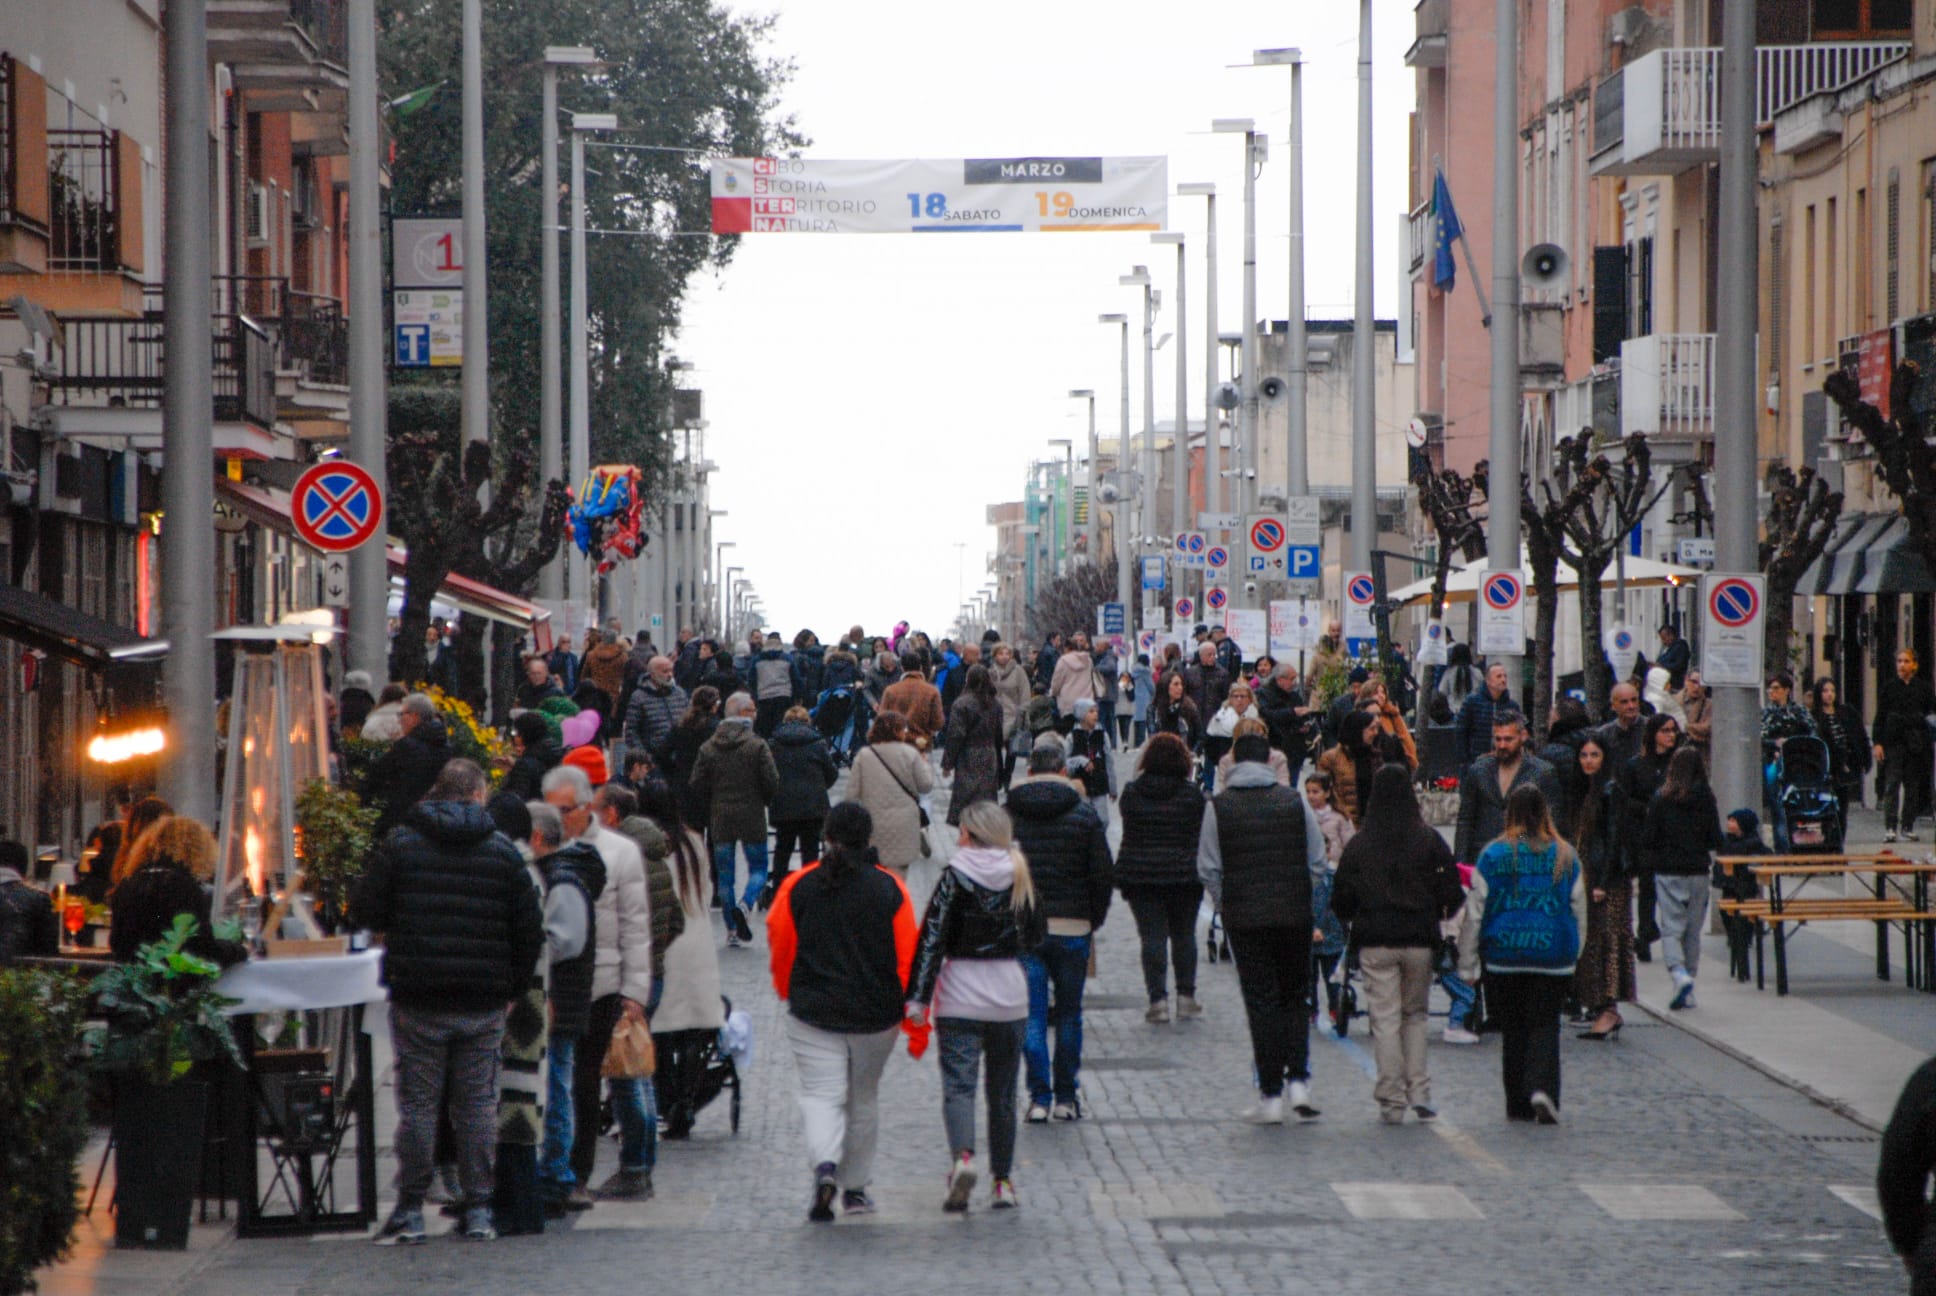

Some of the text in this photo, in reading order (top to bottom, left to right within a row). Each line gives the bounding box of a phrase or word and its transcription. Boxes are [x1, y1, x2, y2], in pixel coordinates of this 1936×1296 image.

[755, 159, 805, 174] CIBO
[1001, 162, 1066, 177] MARZO
[756, 180, 827, 193] STORIA
[756, 199, 877, 214] TERRITORIO
[907, 192, 1001, 221] 18 SABATO
[1034, 191, 1147, 218] 19 DOMENICA
[757, 218, 838, 232] NATURA
[402, 327, 425, 361] T
[1293, 549, 1313, 575] P
